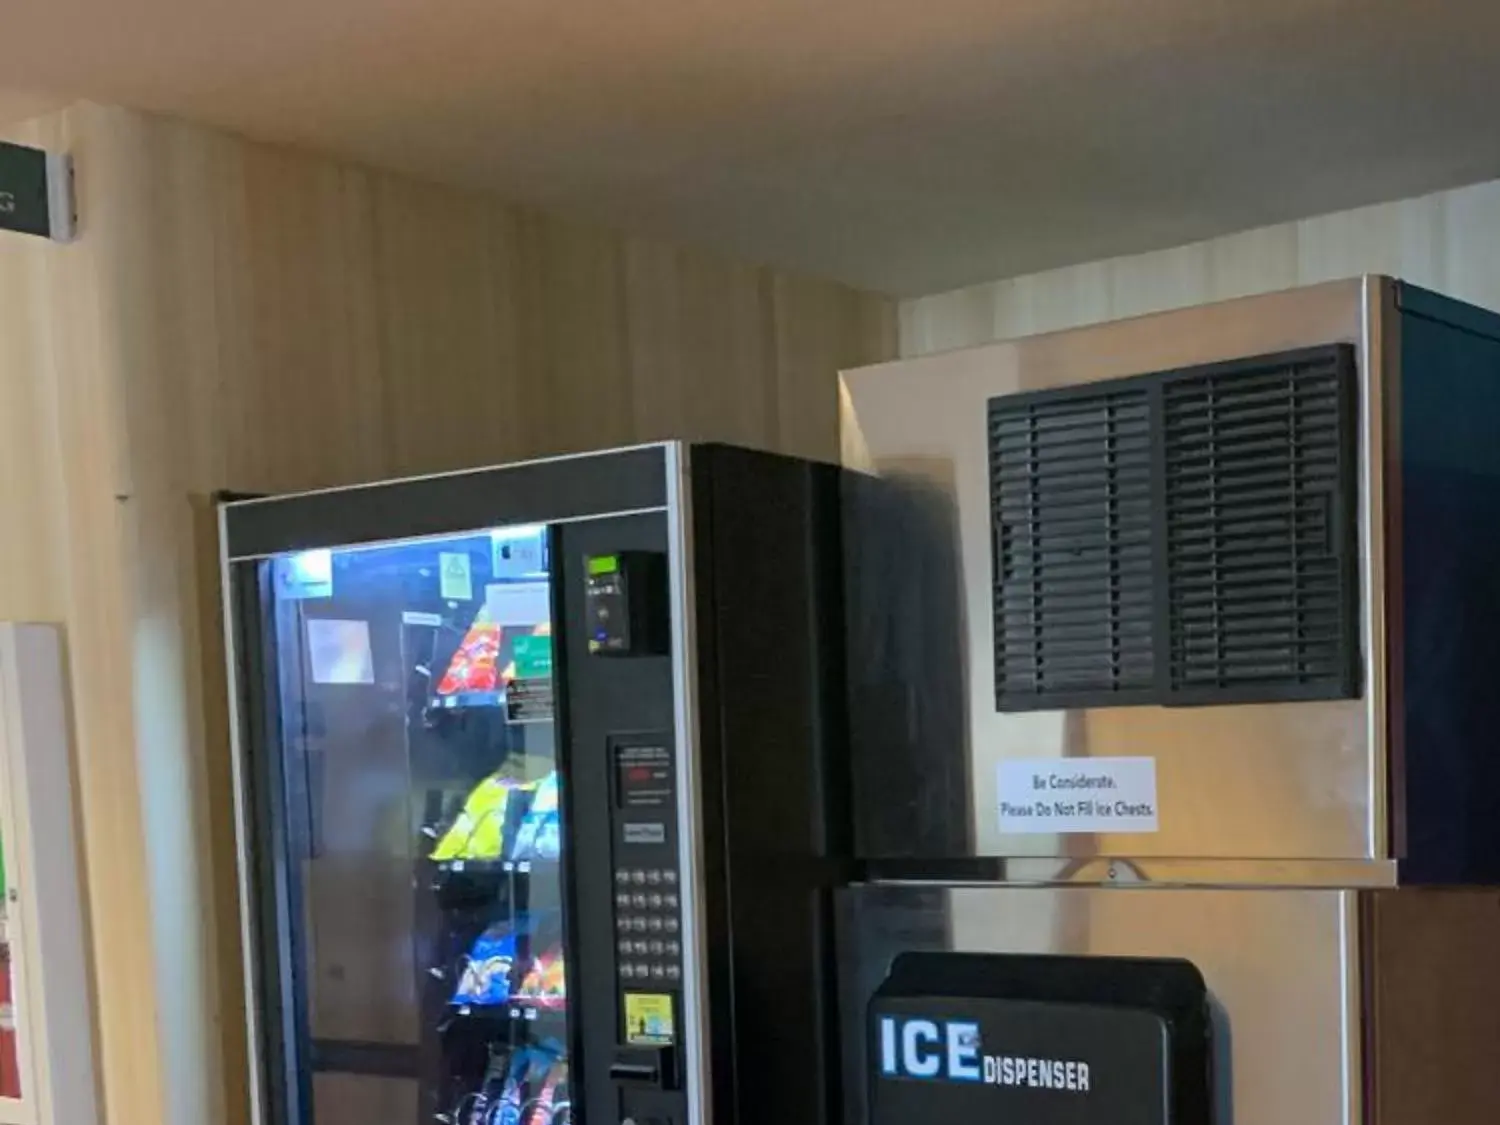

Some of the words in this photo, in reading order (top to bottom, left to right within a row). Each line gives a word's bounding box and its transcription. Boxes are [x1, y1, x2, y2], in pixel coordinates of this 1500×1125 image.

[1032, 775, 1047, 791] Be
[1049, 773, 1118, 791] Considerate.
[1001, 802, 1034, 817] Please
[1037, 802, 1052, 817] Do
[1054, 802, 1075, 817] Not
[1078, 802, 1094, 817] Fill
[1096, 802, 1112, 817] Ice
[1114, 801, 1154, 817] Chests.
[881, 1018, 981, 1081] ICE
[983, 1055, 1090, 1092] DISPENSER
